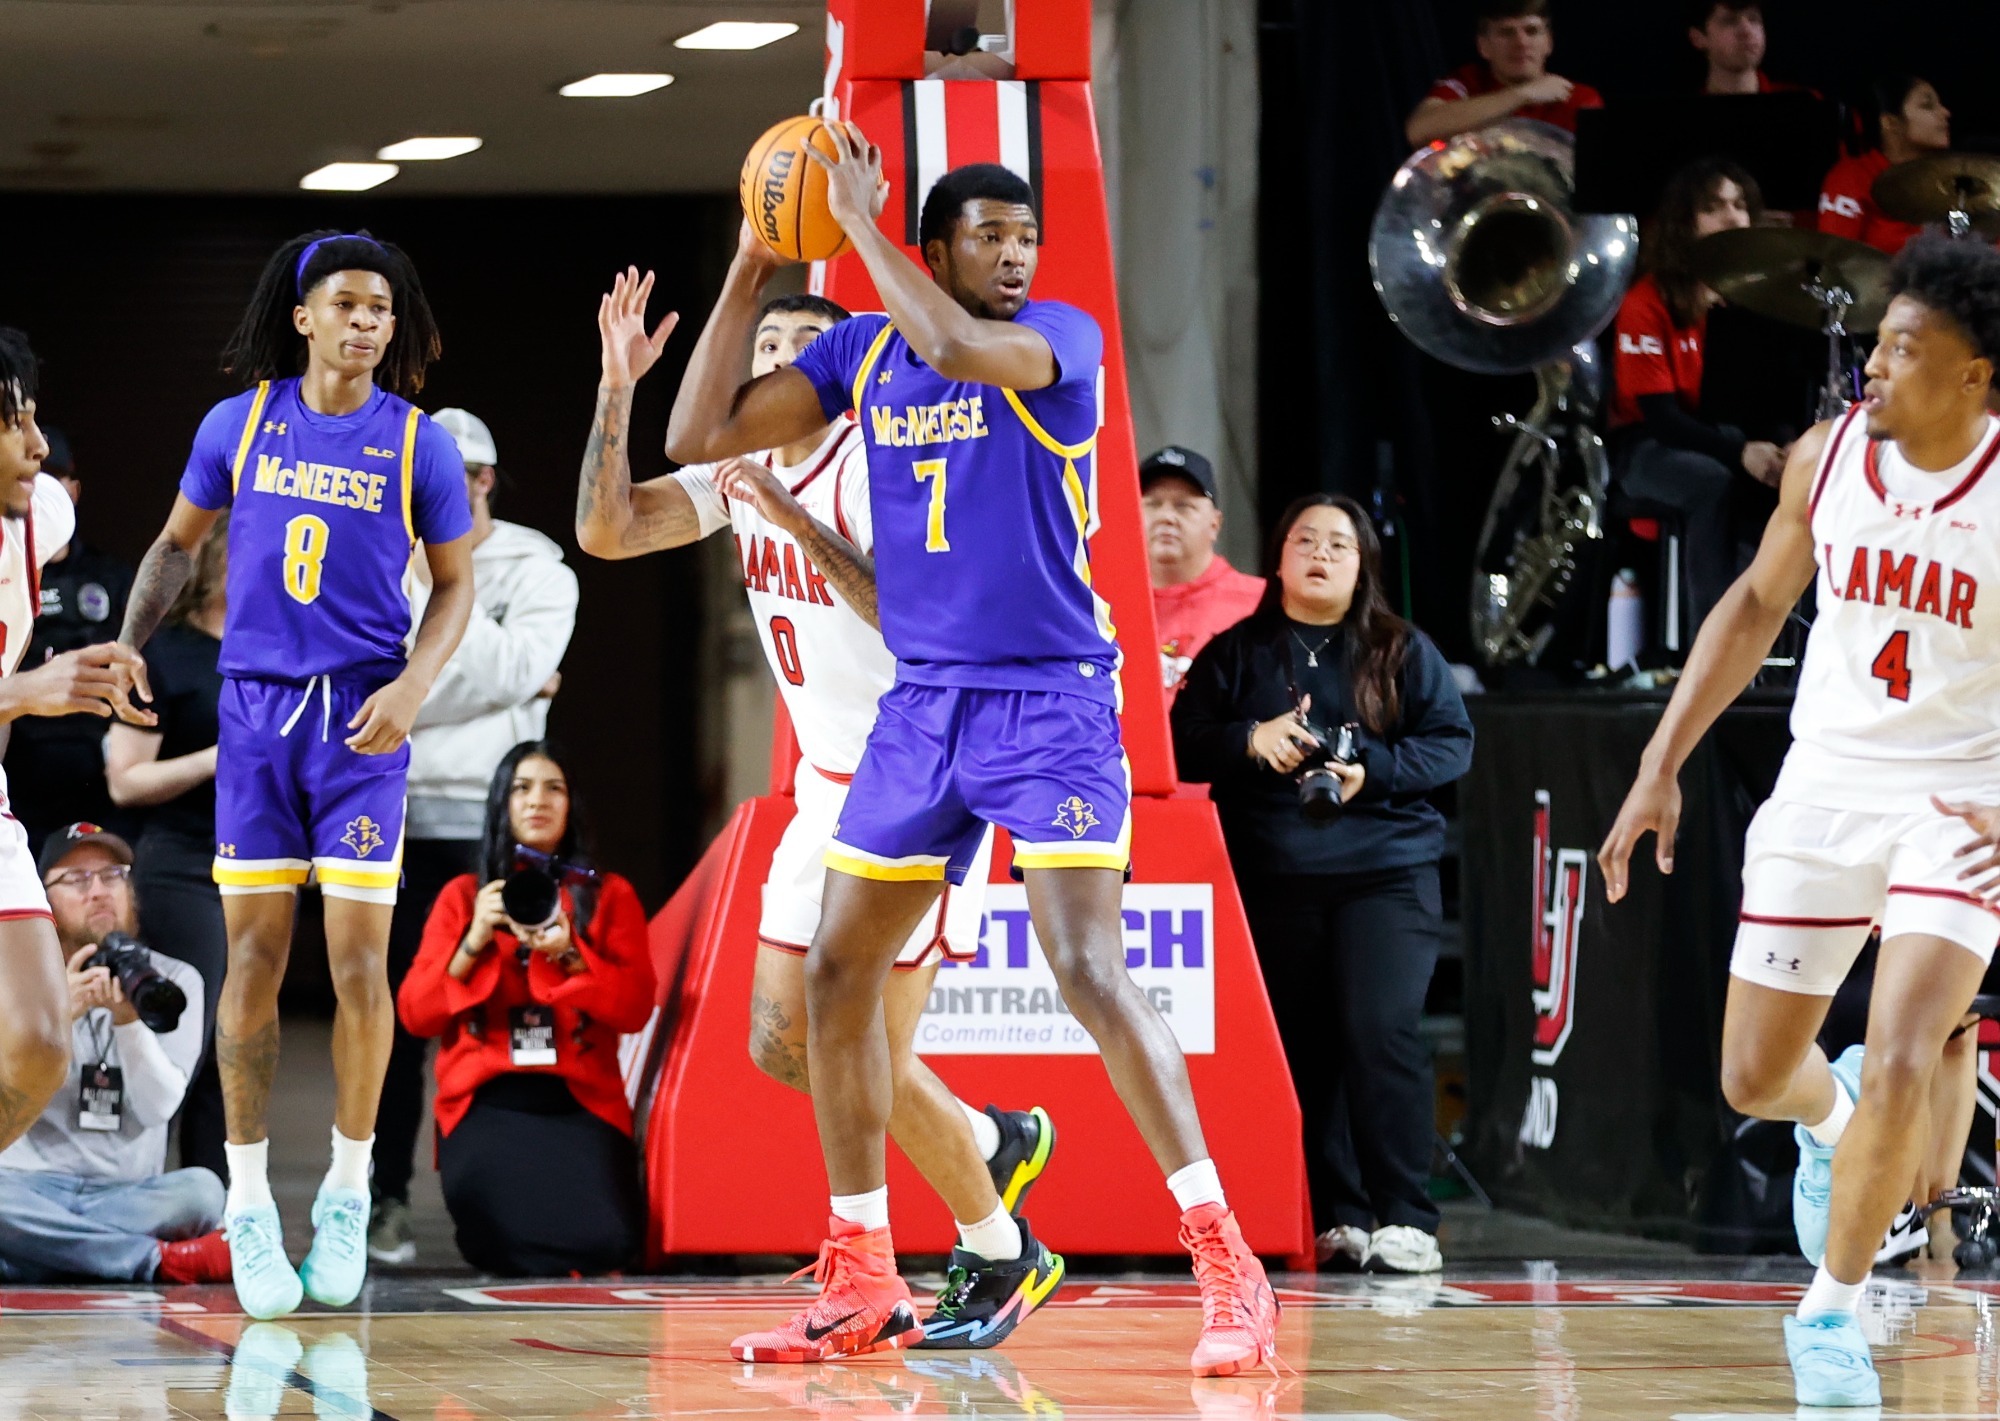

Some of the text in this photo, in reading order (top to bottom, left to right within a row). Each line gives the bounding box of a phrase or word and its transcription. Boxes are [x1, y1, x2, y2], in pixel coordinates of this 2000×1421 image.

[763, 150, 796, 243] Wilson
[253, 454, 387, 513] McNEESE
[363, 446, 396, 459] SLC
[911, 457, 951, 553] 7
[283, 513, 331, 605] 8
[1824, 543, 1978, 630] LAMAR
[769, 615, 806, 688] 0
[1871, 629, 1912, 703] 4
[922, 1022, 1086, 1044] Committed to
